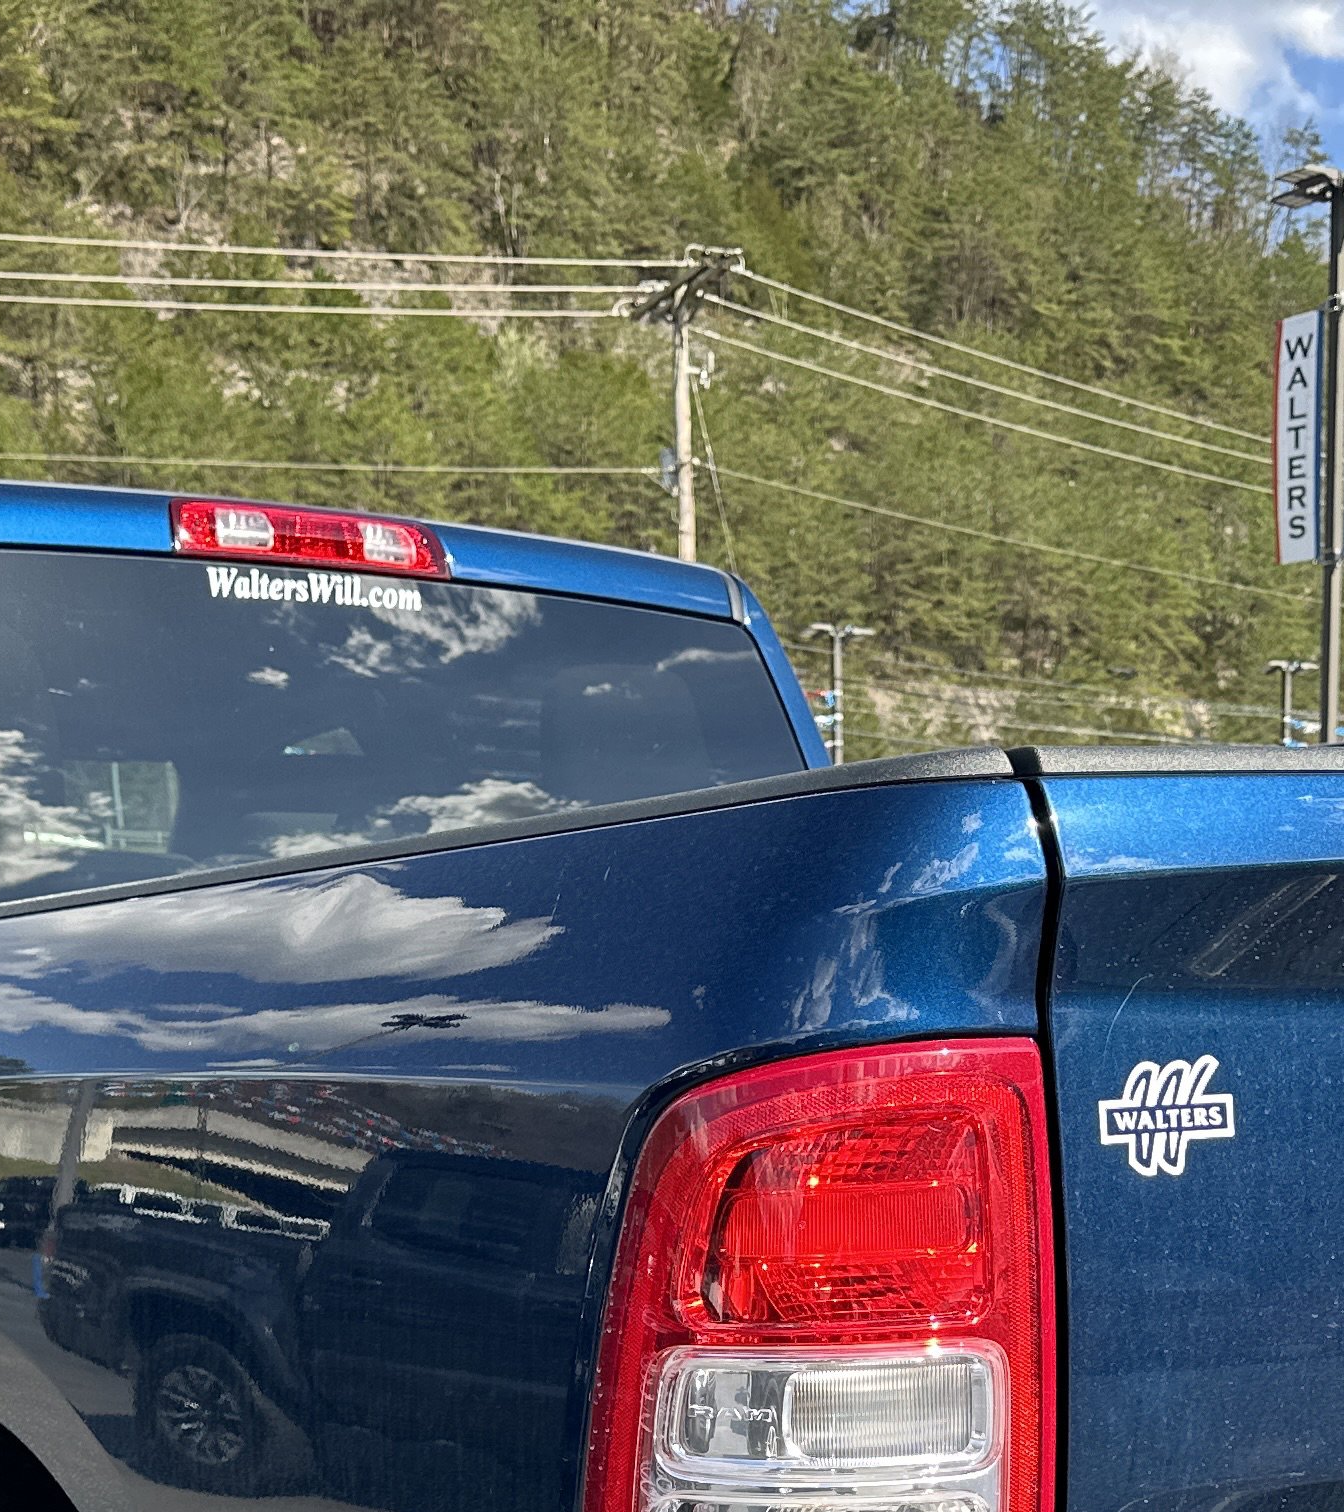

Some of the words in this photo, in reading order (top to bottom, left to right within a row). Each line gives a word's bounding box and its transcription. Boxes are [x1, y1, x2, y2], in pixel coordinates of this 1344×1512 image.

[1284, 333, 1314, 539] WALTERS
[206, 566, 422, 611] WaltersWill.com
[1112, 1106, 1223, 1131] WALTERS
